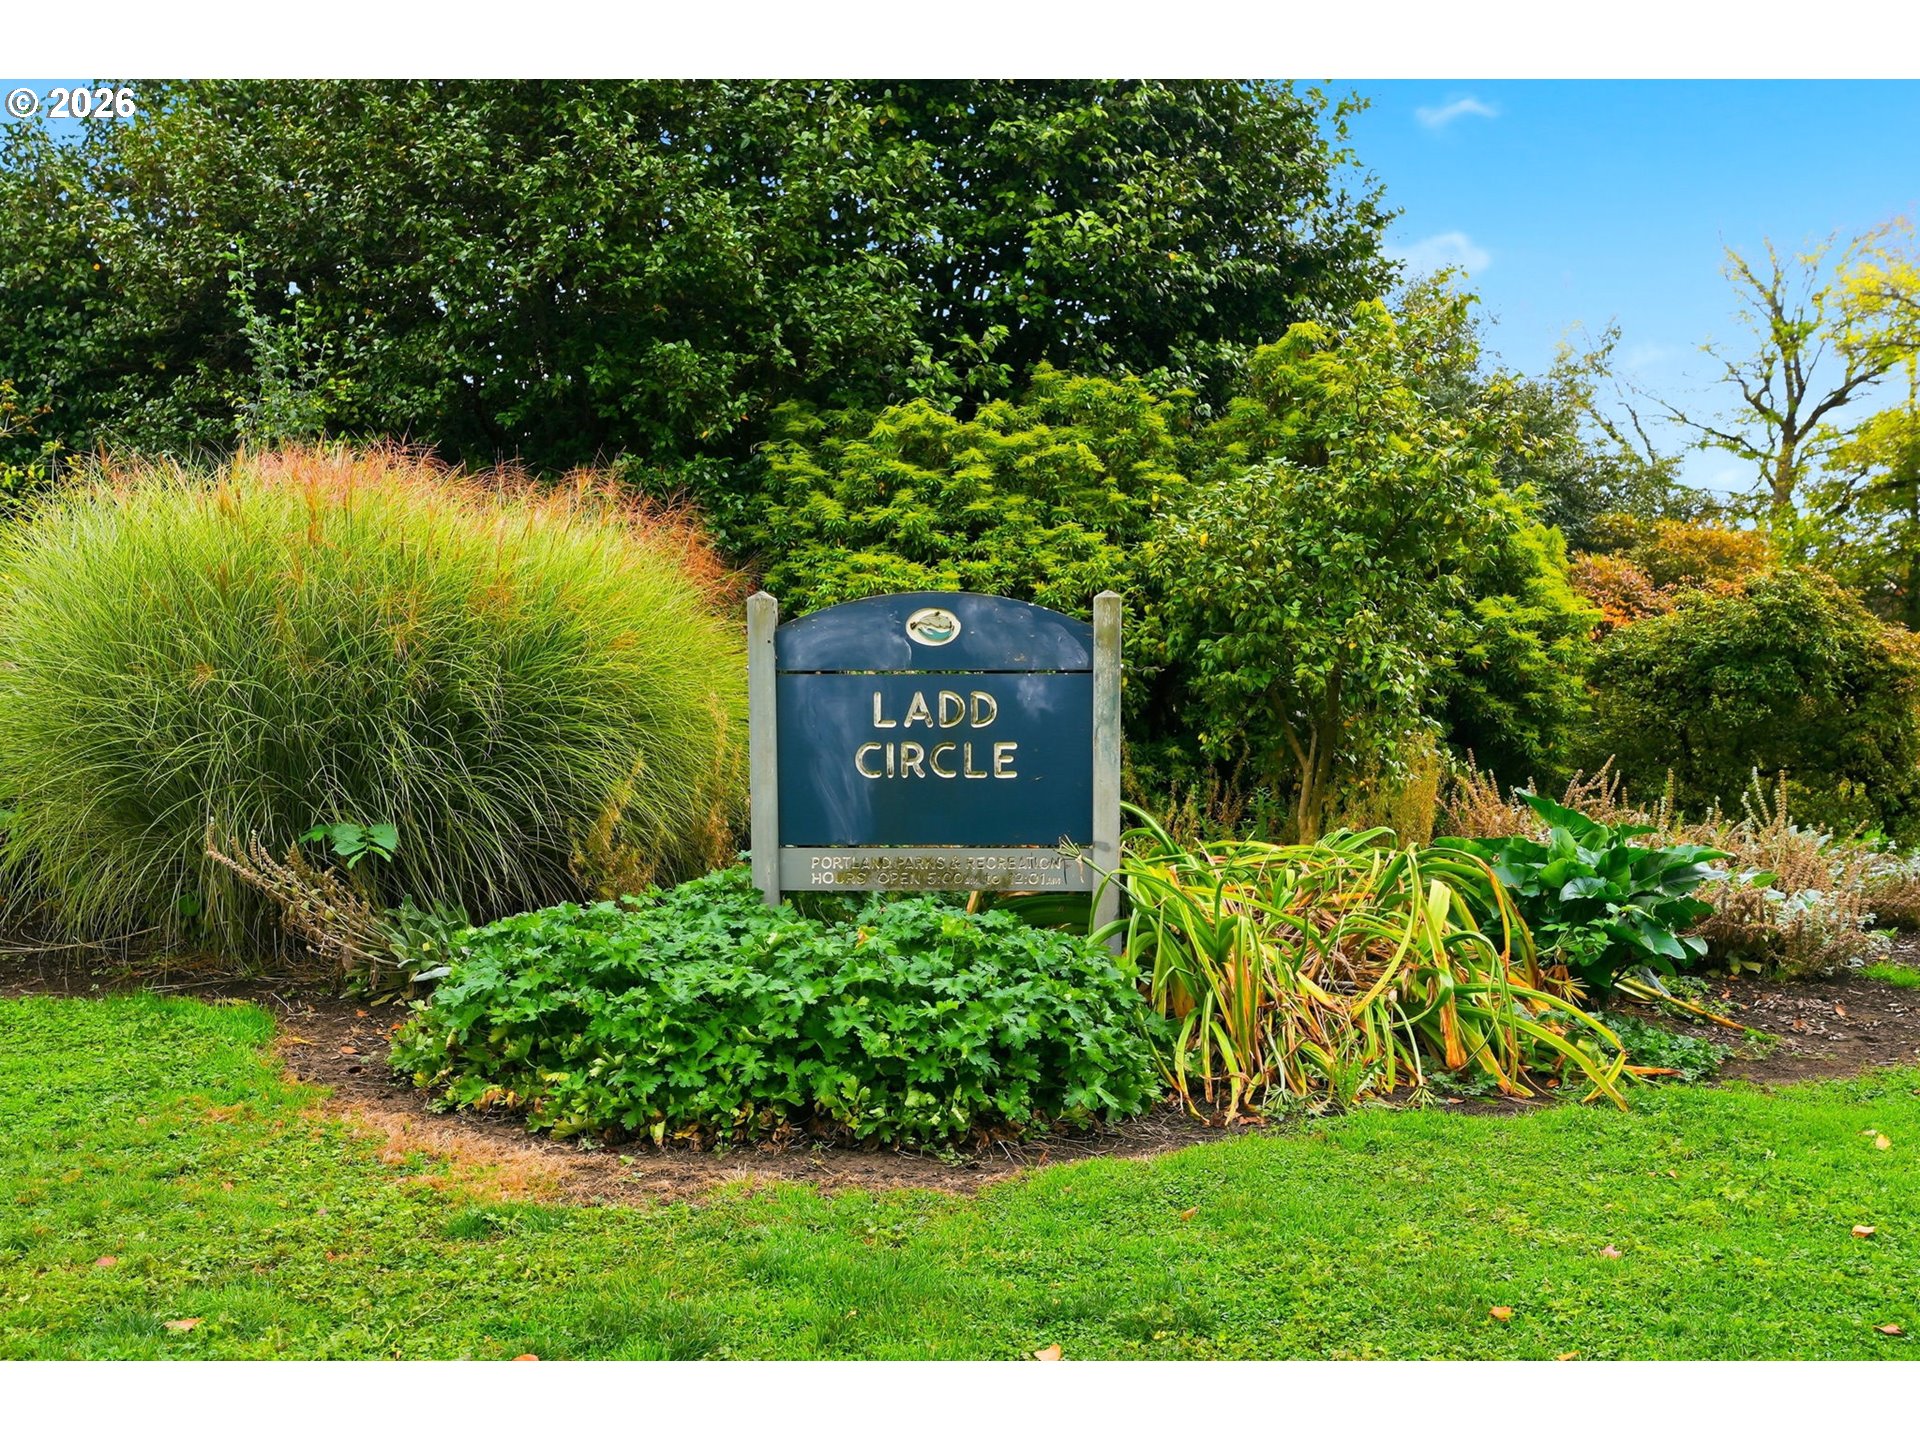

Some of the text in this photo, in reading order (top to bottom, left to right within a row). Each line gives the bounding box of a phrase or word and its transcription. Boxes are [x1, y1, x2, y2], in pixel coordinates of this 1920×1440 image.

[873, 690, 998, 729] LADD
[854, 741, 1018, 779] CIRCLE
[811, 856, 1061, 870] PORTLAND PARKS & RECREATION
[811, 872, 867, 885] HOURS
[878, 872, 921, 885] OPEN
